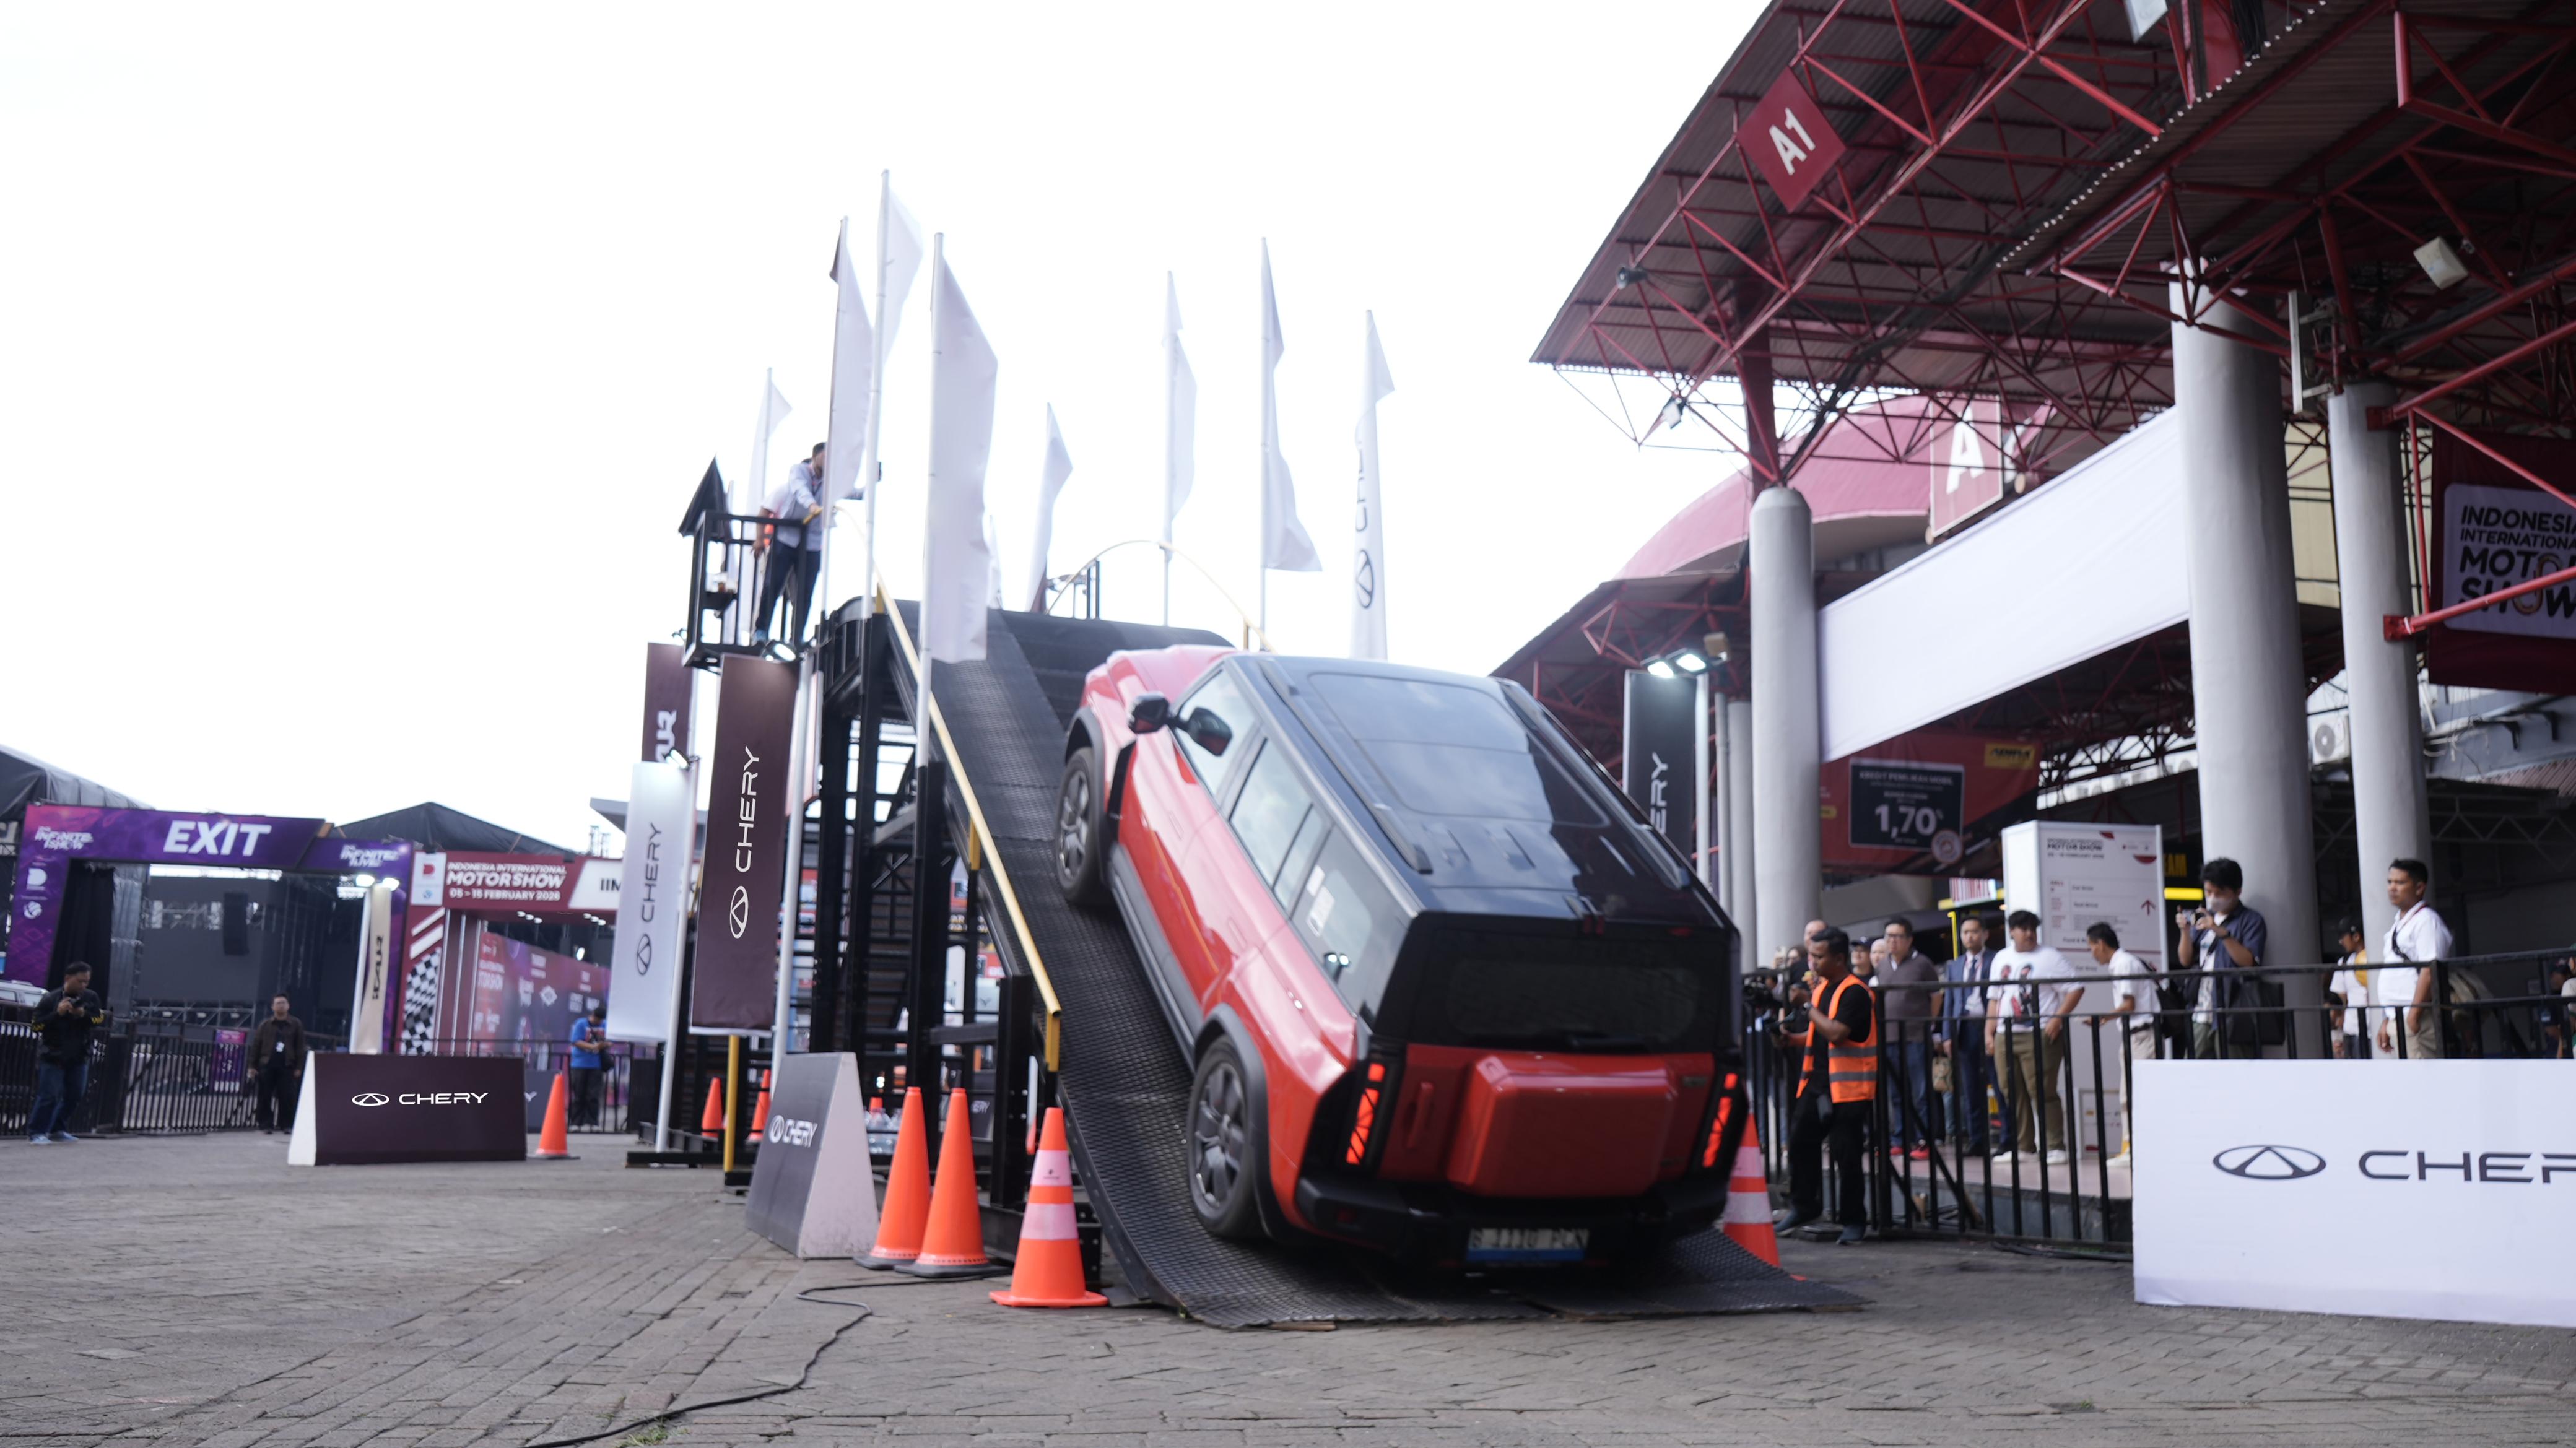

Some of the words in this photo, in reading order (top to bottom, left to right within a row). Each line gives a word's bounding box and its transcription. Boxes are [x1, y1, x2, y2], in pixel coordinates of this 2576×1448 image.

[1769, 108, 1816, 175] A1
[2459, 545, 2576, 578] MOTO
[736, 745, 760, 873] CHERY
[163, 820, 272, 856] EXIT
[447, 861, 495, 871] INDONESIA
[497, 863, 567, 874] INTERNATIONAL
[642, 822, 662, 923] CHERY
[485, 889, 535, 900] FEBRUARY
[398, 1092, 489, 1105] CHERY
[782, 1118, 818, 1148] CHERY
